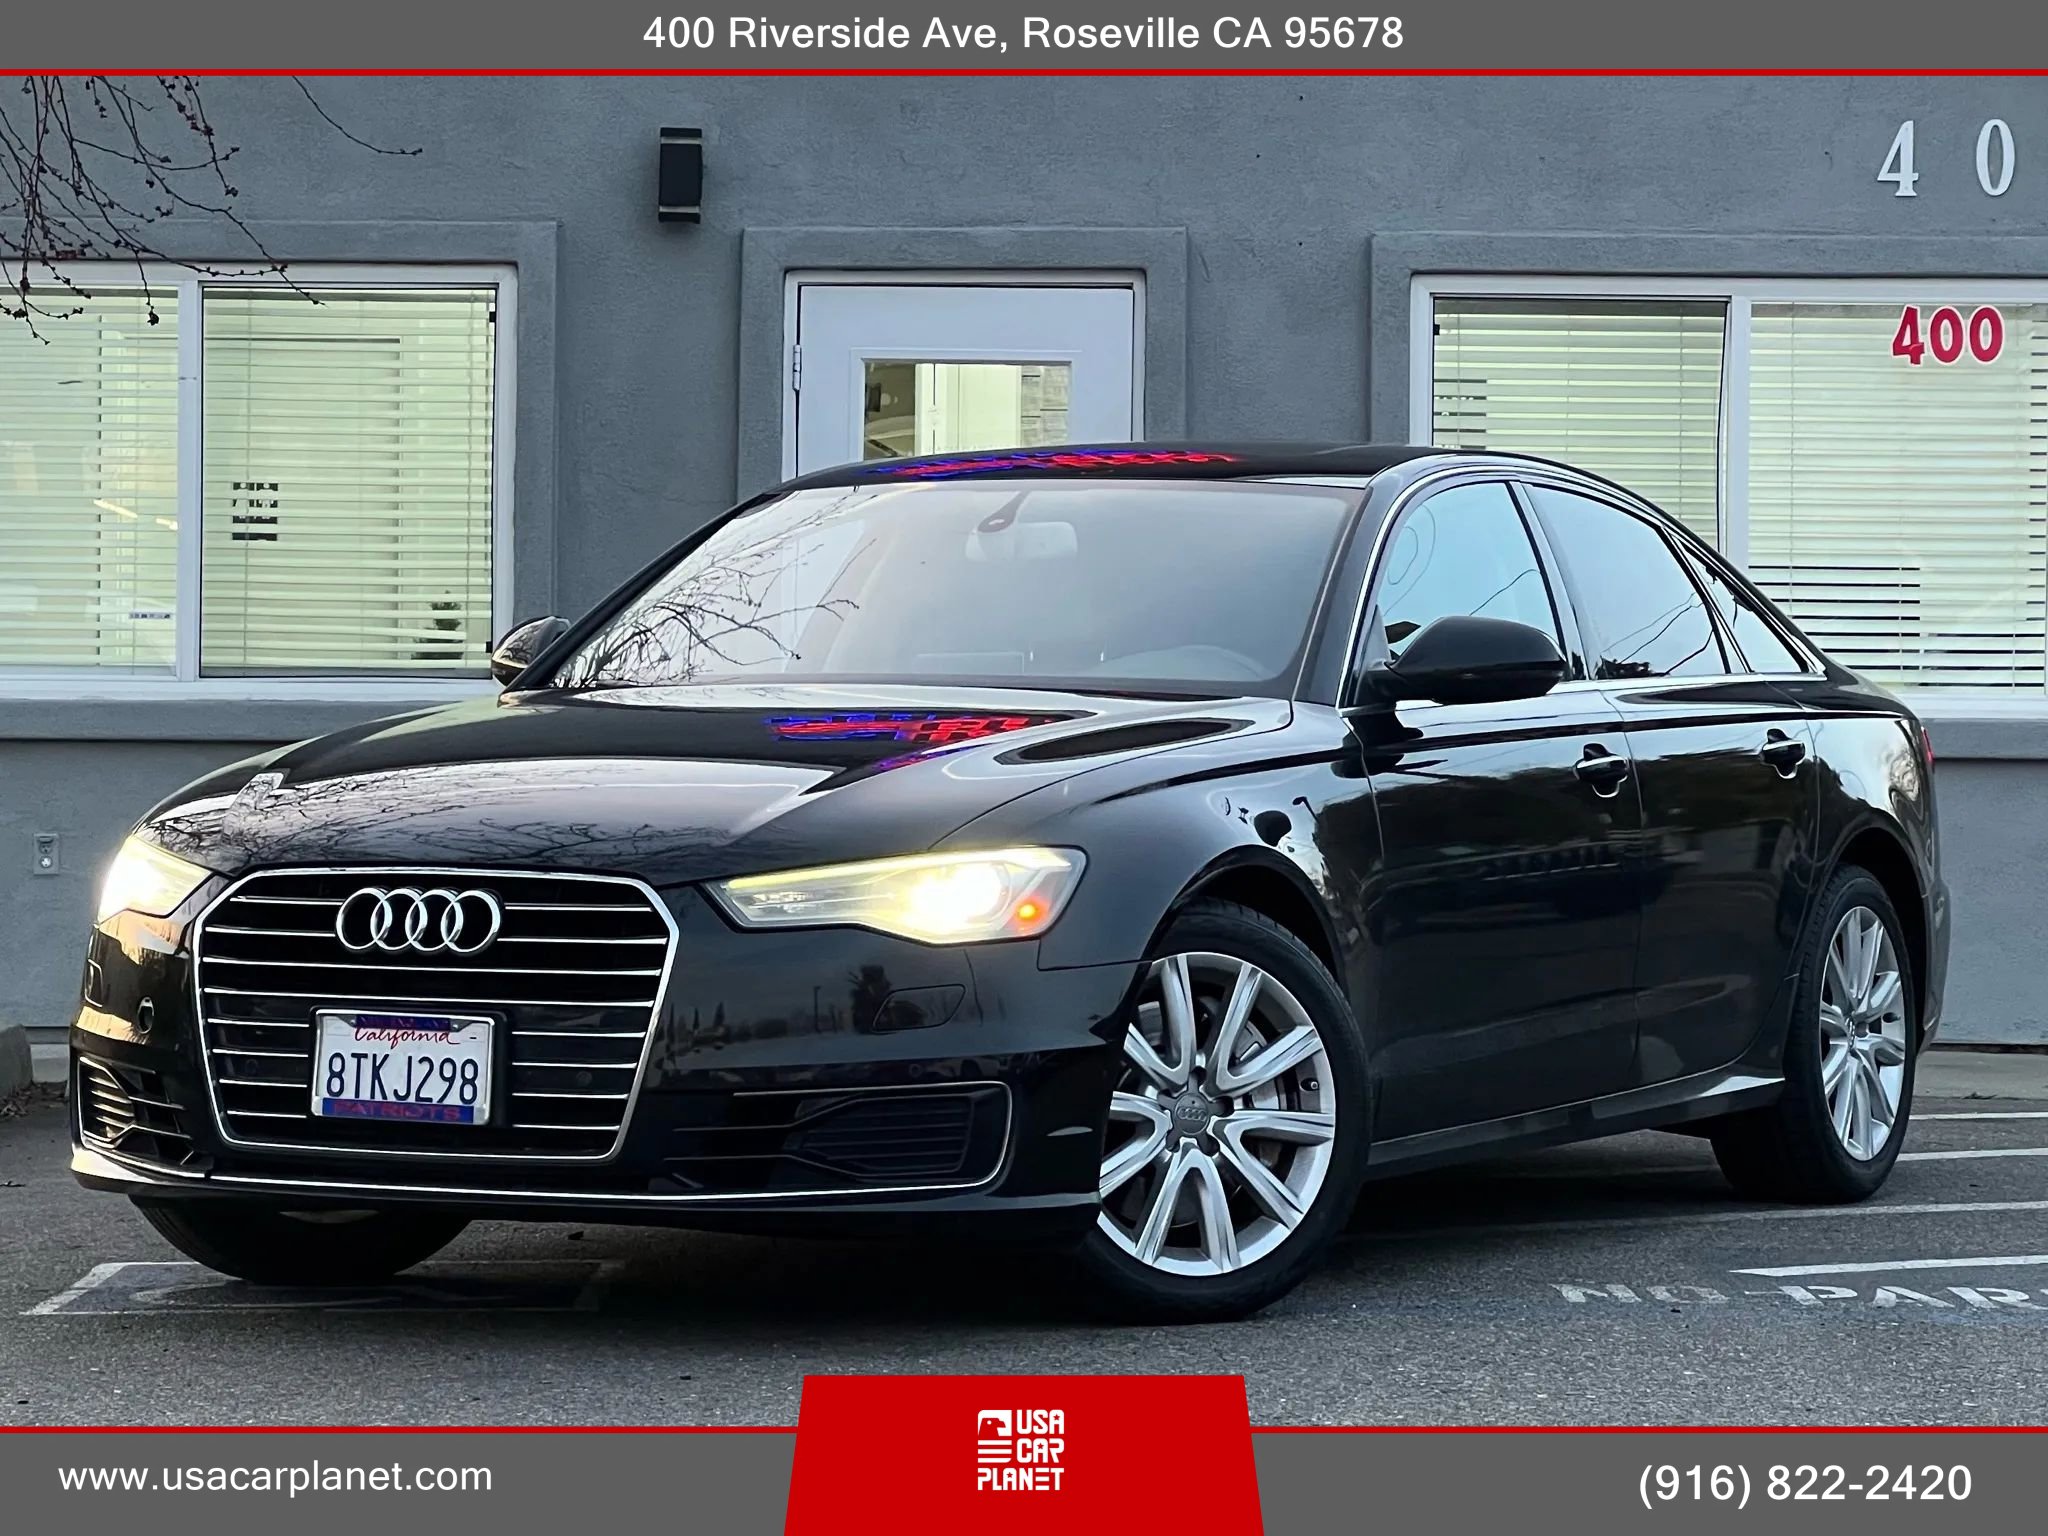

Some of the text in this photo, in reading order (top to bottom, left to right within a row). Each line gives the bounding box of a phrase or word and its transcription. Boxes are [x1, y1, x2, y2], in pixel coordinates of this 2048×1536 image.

[1892, 306, 2003, 365] 400
[354, 1028, 460, 1049] California
[326, 1052, 479, 1105] 8TKJ298
[334, 1101, 462, 1120] PATRIOTS
[1778, 1285, 2048, 1308] PAR
